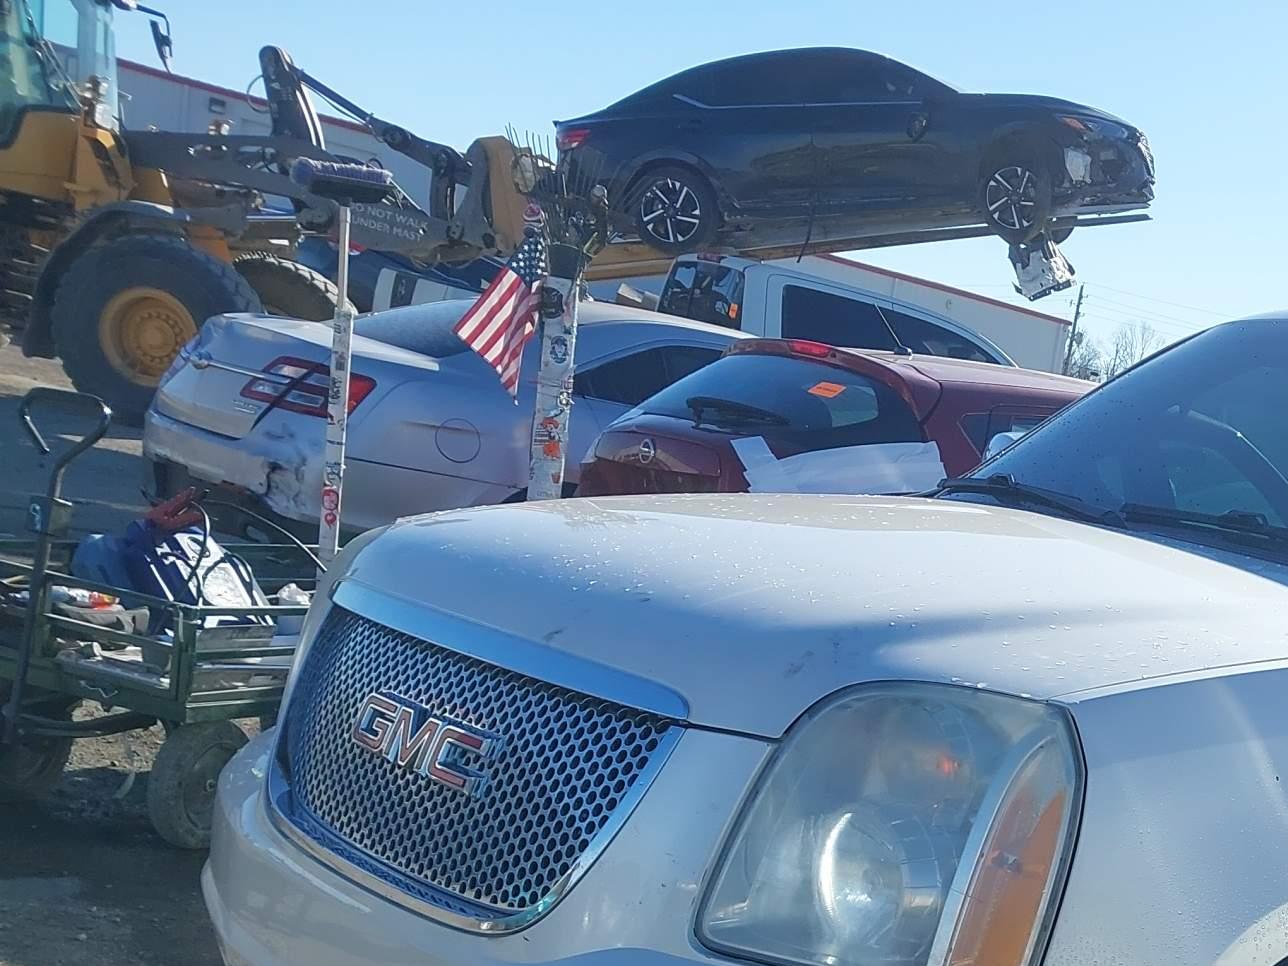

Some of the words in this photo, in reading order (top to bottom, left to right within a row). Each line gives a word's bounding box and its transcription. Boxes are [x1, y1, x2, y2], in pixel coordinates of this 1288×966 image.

[351, 214, 390, 232] UNDER
[393, 226, 422, 241] MAST
[367, 206, 393, 220] NOT
[395, 213, 429, 230] WALK
[352, 690, 502, 799] GMC
